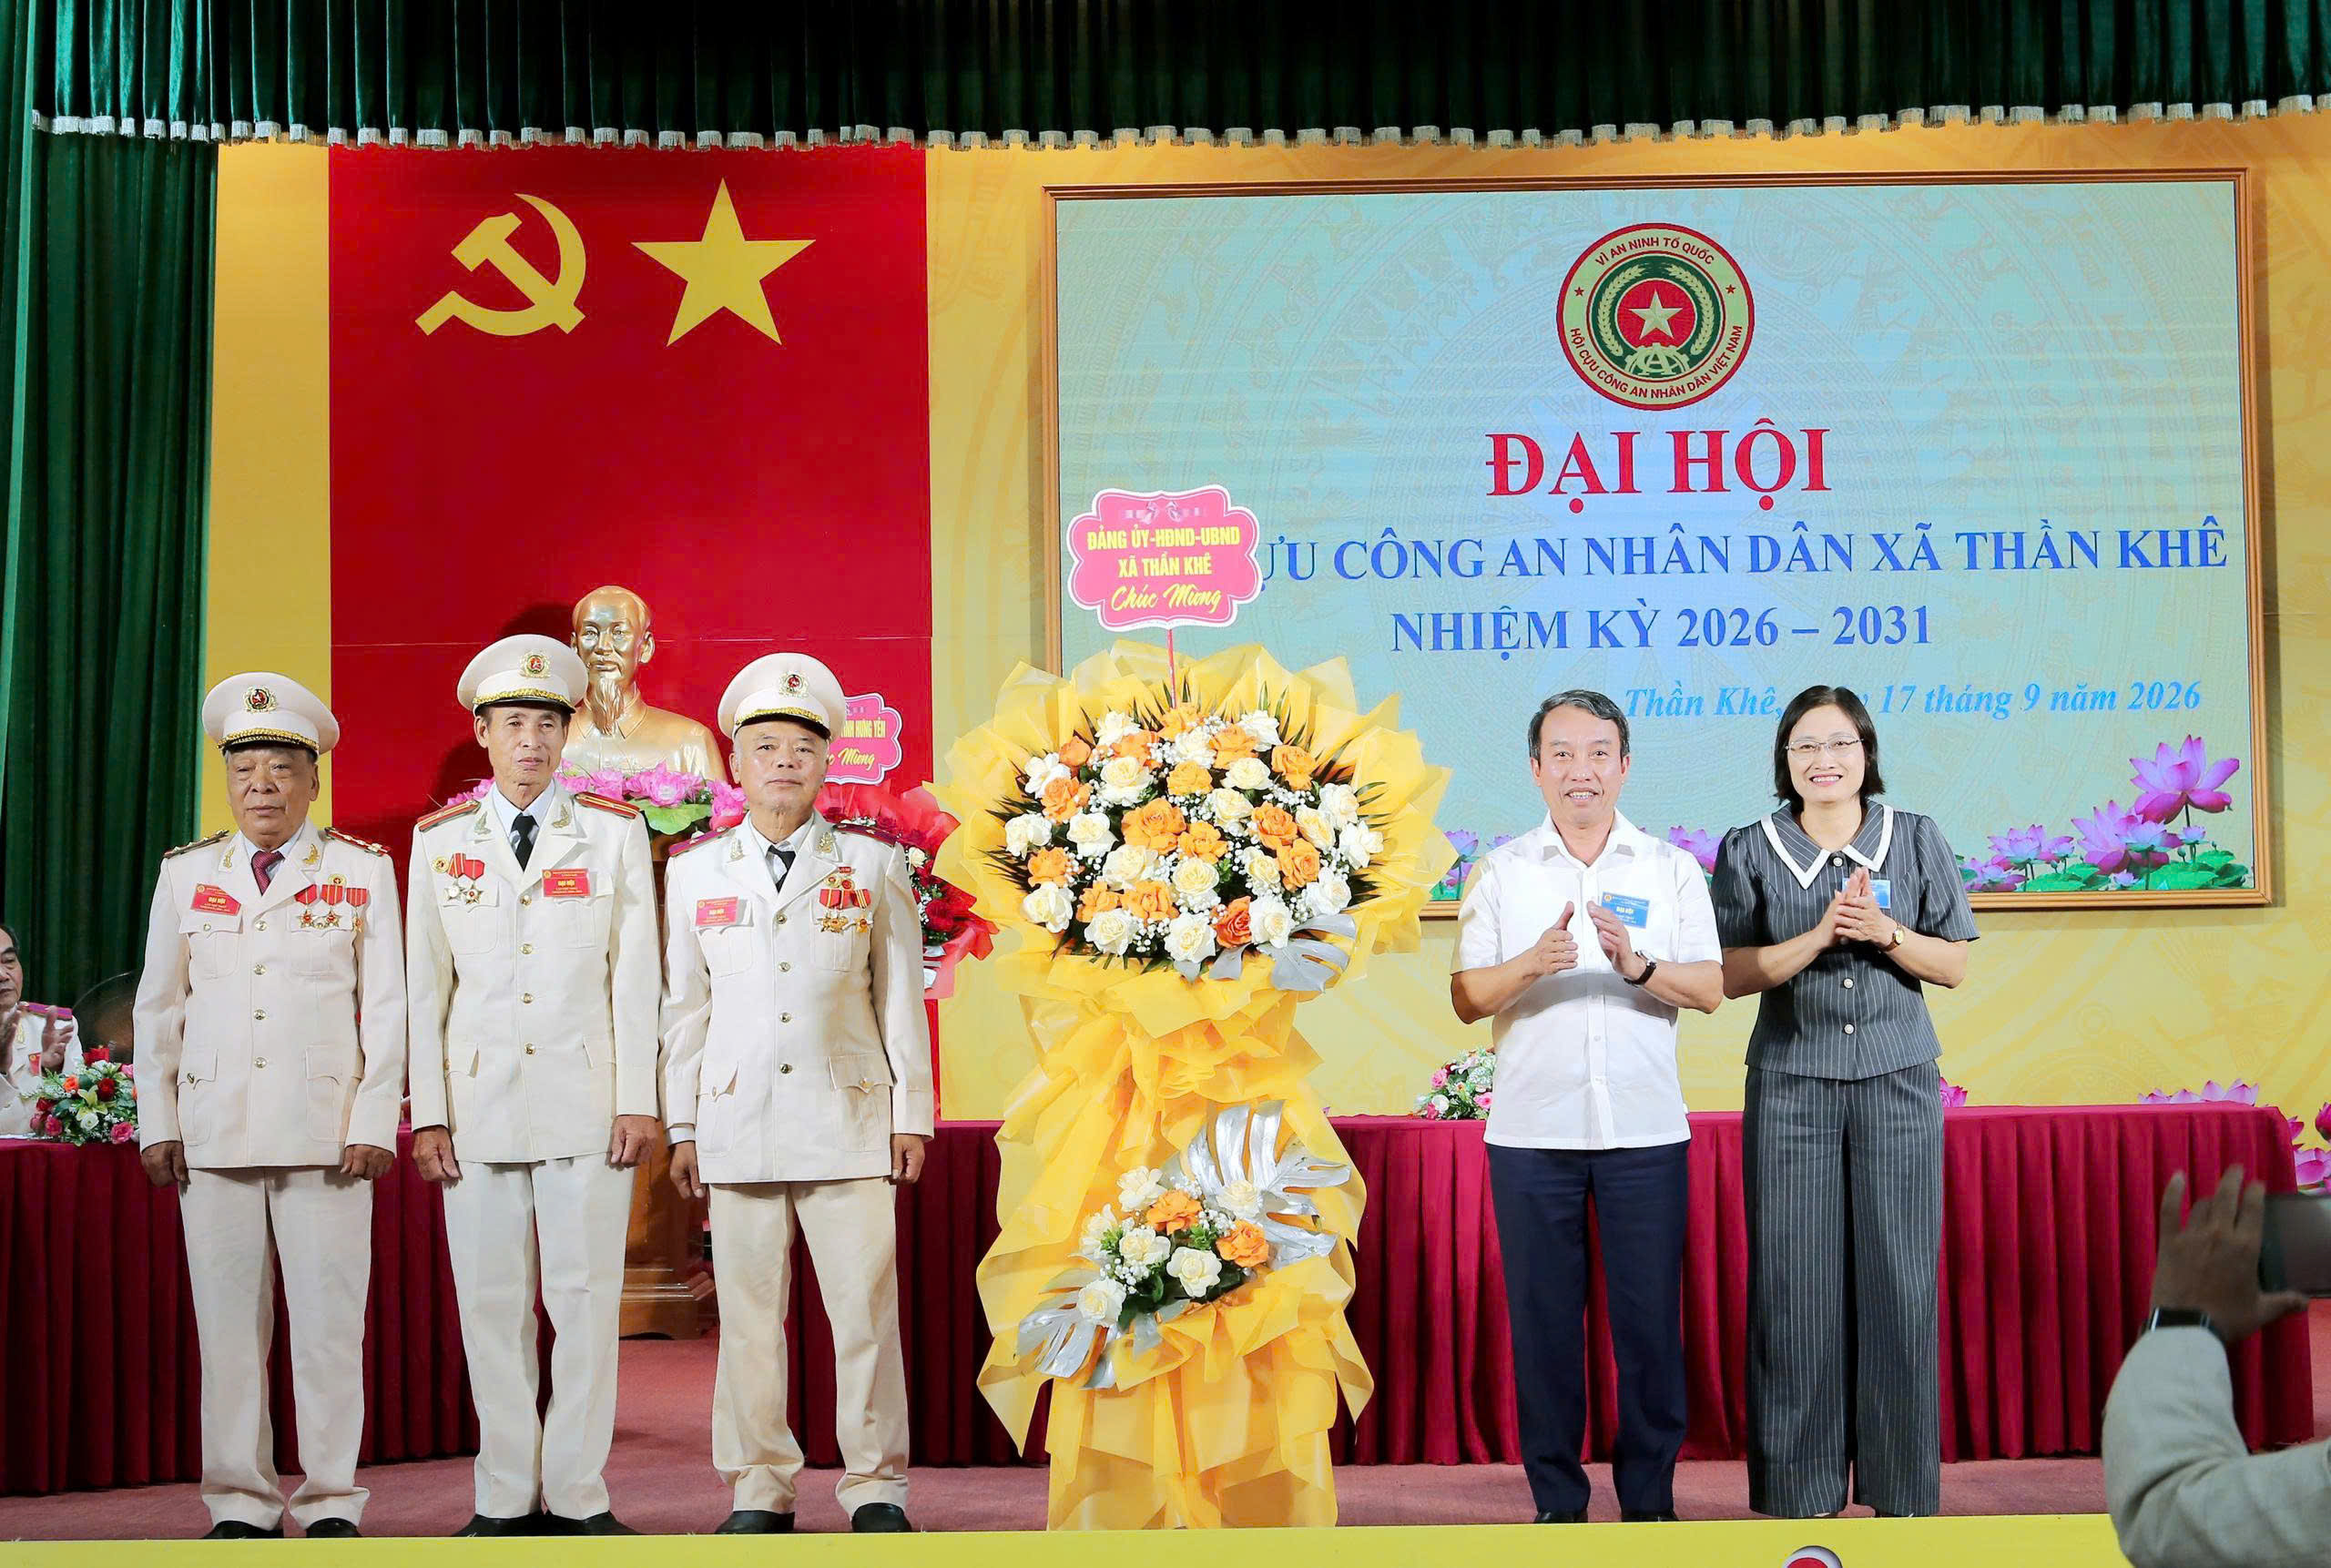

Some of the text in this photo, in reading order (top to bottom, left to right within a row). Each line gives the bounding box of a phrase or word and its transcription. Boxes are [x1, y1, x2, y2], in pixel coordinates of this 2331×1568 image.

[1595, 251, 1609, 266] VÌ
[1610, 243, 1627, 259] AN
[1628, 237, 1659, 250] NINH
[1571, 328, 1585, 349] HỘI
[1597, 370, 1629, 392] CÔNG
[1630, 386, 1648, 398] AN
[1650, 384, 1686, 399] NHÂN
[1686, 374, 1712, 392] DÂN
[1708, 351, 1731, 375] VIỆT
[1725, 325, 1743, 353] NAM
[1486, 418, 1832, 514] ĐẠI HỘI
[1087, 524, 1127, 551] ĐẢNG
[1255, 515, 2228, 591] ỰU CÔNG AN NHÂN DÂN XÃ THẦN KHÊ
[1118, 555, 1138, 577] XÃ
[1111, 584, 1158, 611] Chúc
[1389, 605, 1571, 661] NHIỆM
[1585, 597, 1663, 649] KỲ
[1676, 606, 1779, 648] 2026
[1832, 605, 1932, 646] 2031
[1624, 680, 1705, 718] Thần
[1878, 684, 1917, 714] 17
[1924, 682, 2011, 720] tháng
[2024, 683, 2041, 711] 9
[2049, 684, 2117, 711] năm
[2126, 680, 2201, 710] 2026
